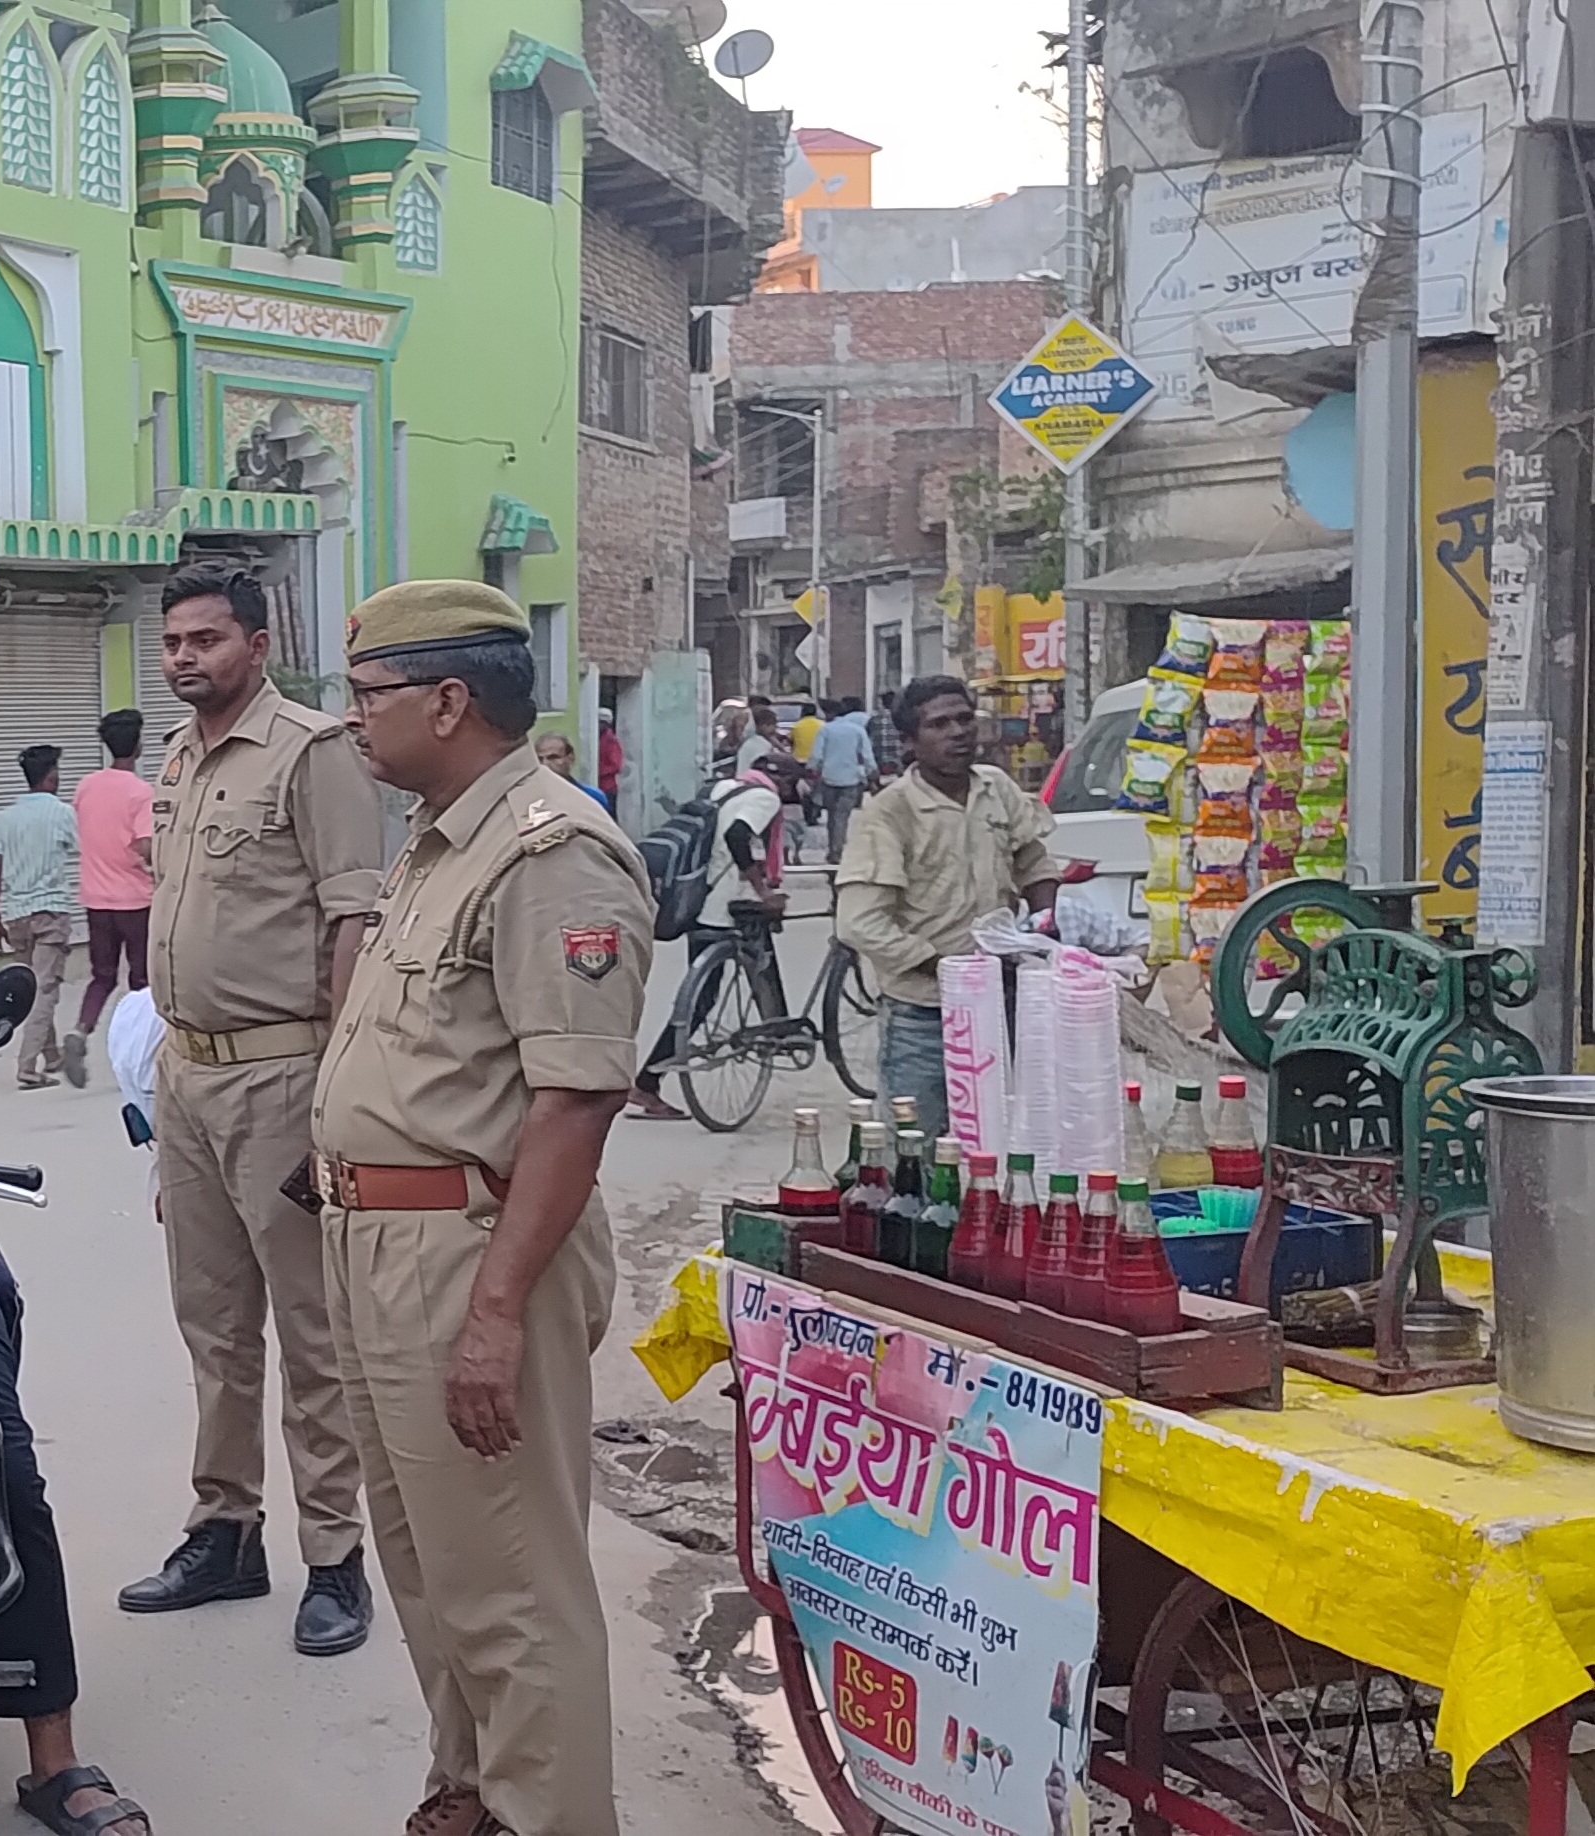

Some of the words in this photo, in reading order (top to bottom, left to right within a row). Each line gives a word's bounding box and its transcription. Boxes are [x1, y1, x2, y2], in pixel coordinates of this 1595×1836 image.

[1010, 369, 1136, 396] LEARNER'S
[1030, 391, 1111, 408] ACADEMY
[1006, 1371, 1102, 1435] 841989
[786, 1577, 842, 1618] अवसर
[842, 1605, 867, 1634] पर
[870, 1621, 935, 1663] सम्पर्क
[865, 1565, 897, 1595] एवं
[895, 1572, 947, 1621] किसी
[951, 1599, 979, 1633] भी
[980, 1616, 1018, 1653] शुभ
[891, 1675, 906, 1710] 5
[883, 1711, 912, 1753] 10
[956, 1804, 978, 1828] के
